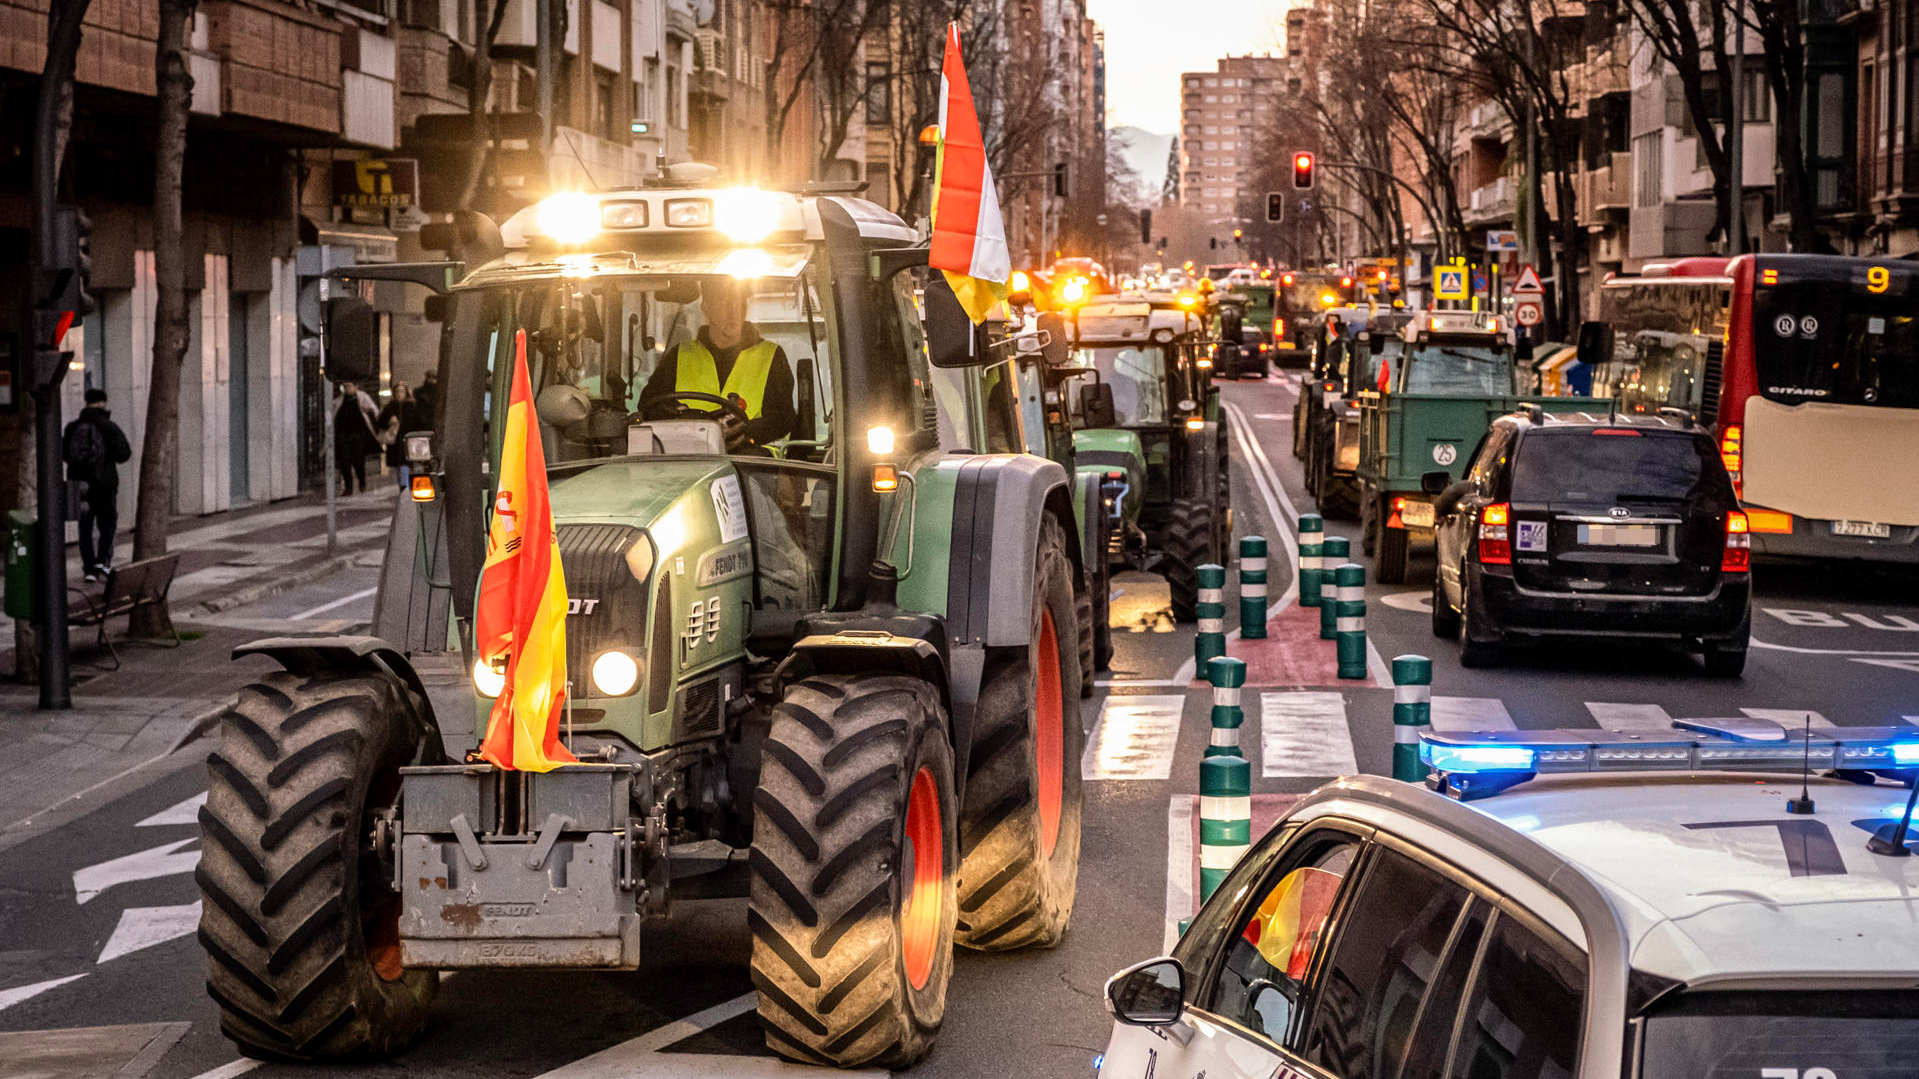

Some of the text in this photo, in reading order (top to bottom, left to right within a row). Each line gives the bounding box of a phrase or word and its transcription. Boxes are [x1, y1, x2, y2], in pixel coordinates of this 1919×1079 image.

[1867, 266, 1890, 293] 9
[1521, 310, 1537, 320] 30
[1768, 386, 1827, 397] CITARO
[1438, 444, 1453, 462] 25
